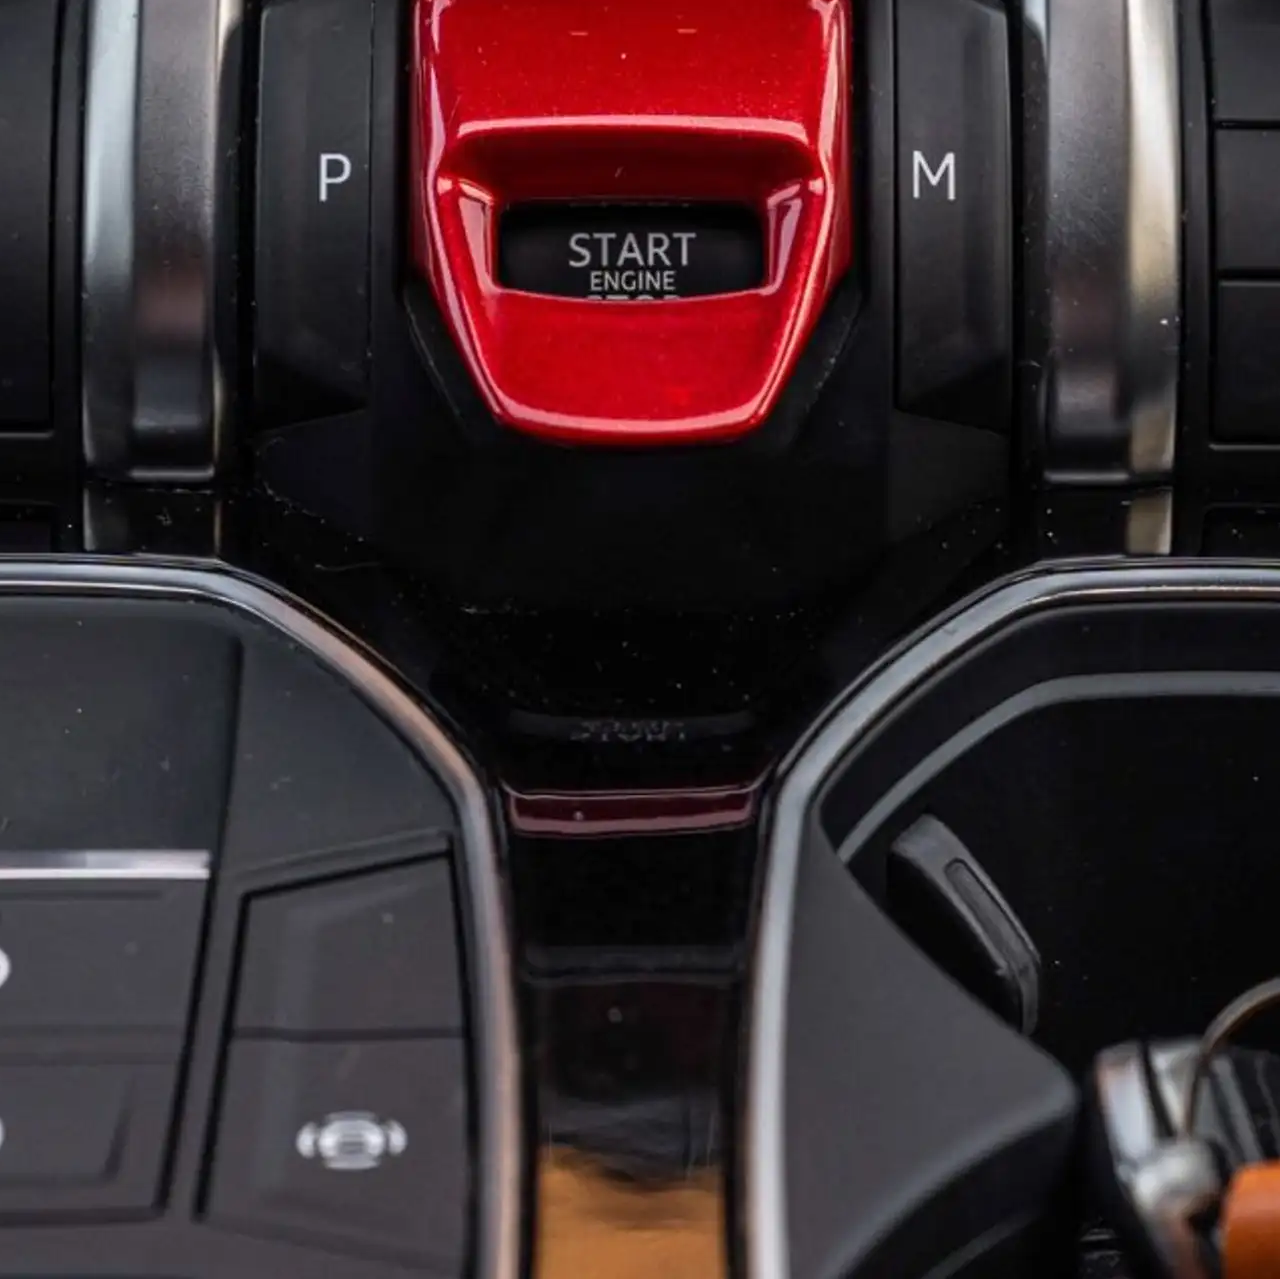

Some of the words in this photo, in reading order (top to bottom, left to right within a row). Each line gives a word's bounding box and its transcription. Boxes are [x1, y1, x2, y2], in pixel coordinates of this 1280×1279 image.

[319, 153, 352, 202] P
[912, 150, 956, 201] M
[568, 232, 696, 268] START
[590, 270, 676, 291] ENGINE
